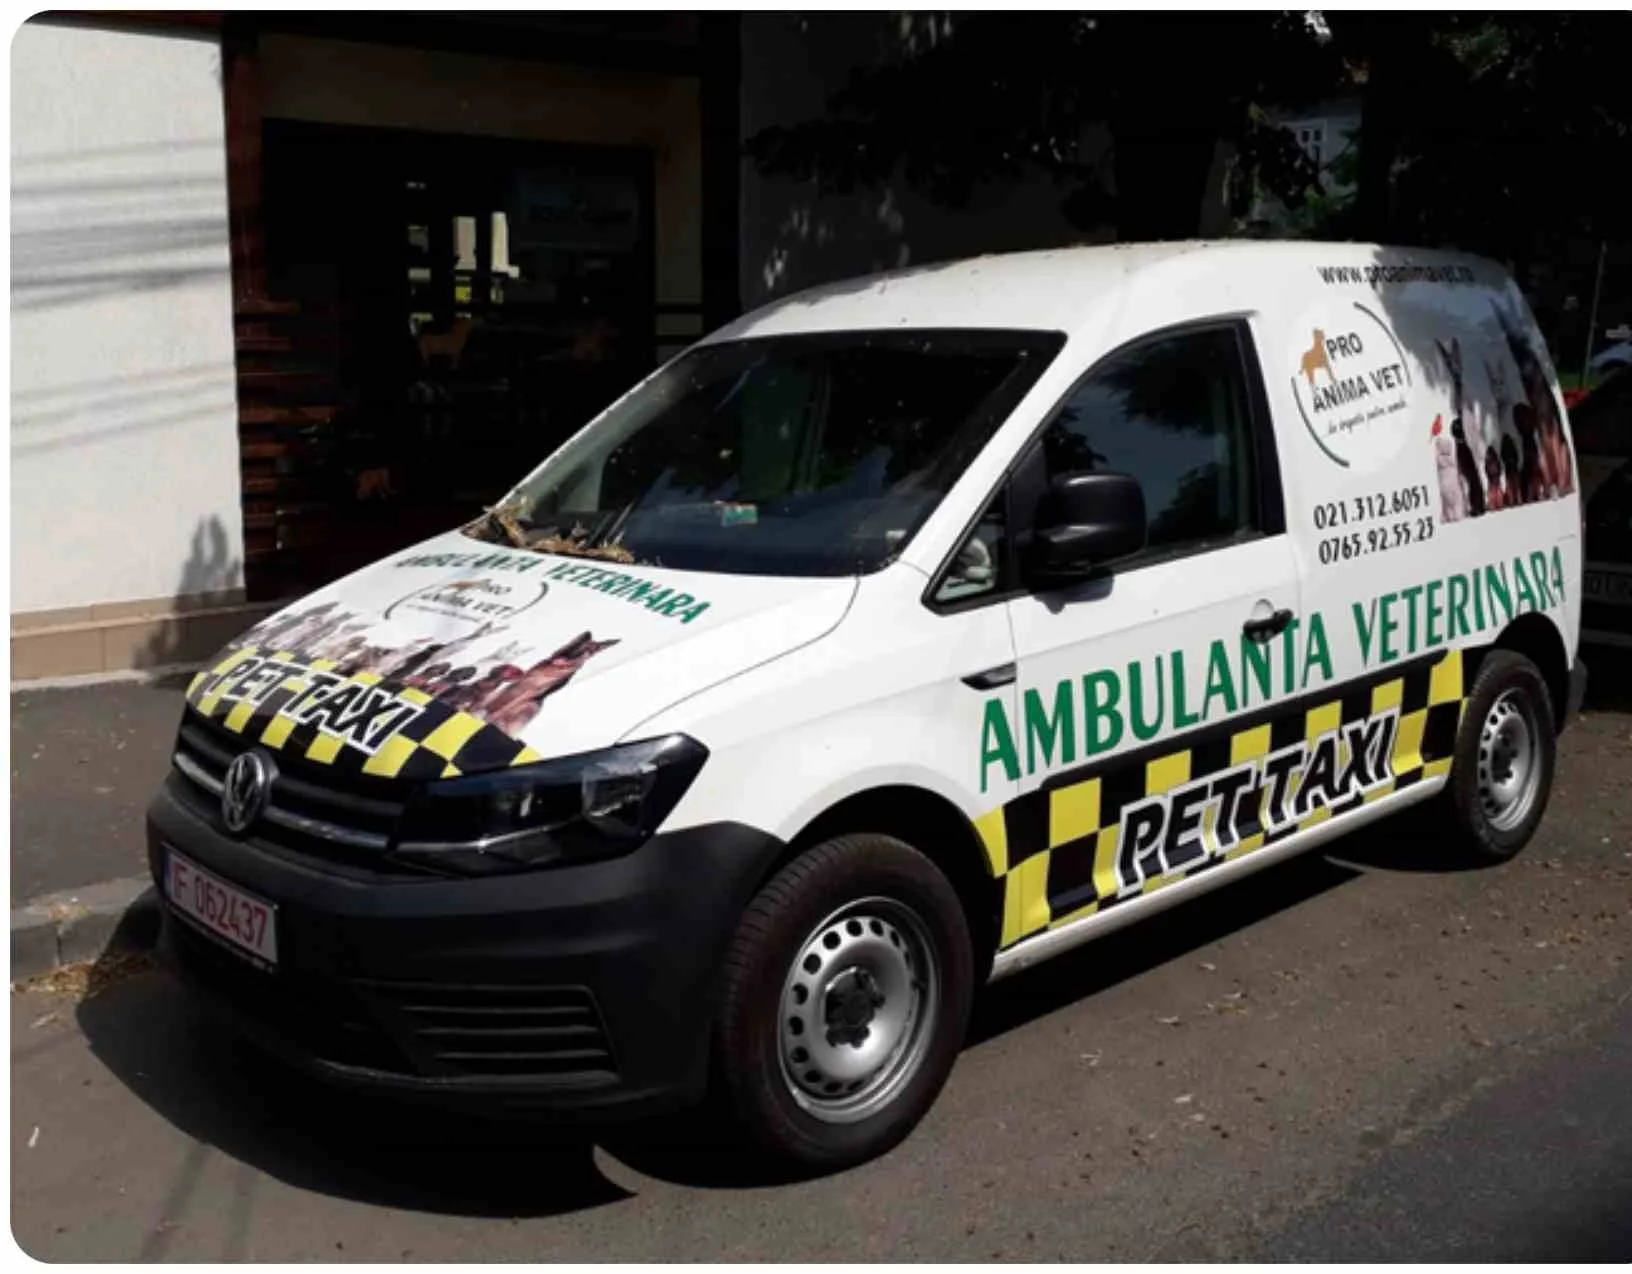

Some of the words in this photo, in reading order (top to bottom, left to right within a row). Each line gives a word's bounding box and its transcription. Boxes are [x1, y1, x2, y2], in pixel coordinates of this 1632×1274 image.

[1326, 332, 1363, 361] PRO
[1313, 375, 1370, 413] ANIMA
[1369, 363, 1403, 392] VET
[1313, 485, 1429, 530] 021.312.6051
[1318, 516, 1434, 565] 0765.92.55.23
[980, 612, 1335, 793] AMBULANTA
[1351, 545, 1566, 668] VETERINARA
[203, 656, 312, 706] PET
[278, 671, 425, 756] TAXI
[1116, 761, 1257, 898] PET
[1261, 706, 1400, 836] TAXI
